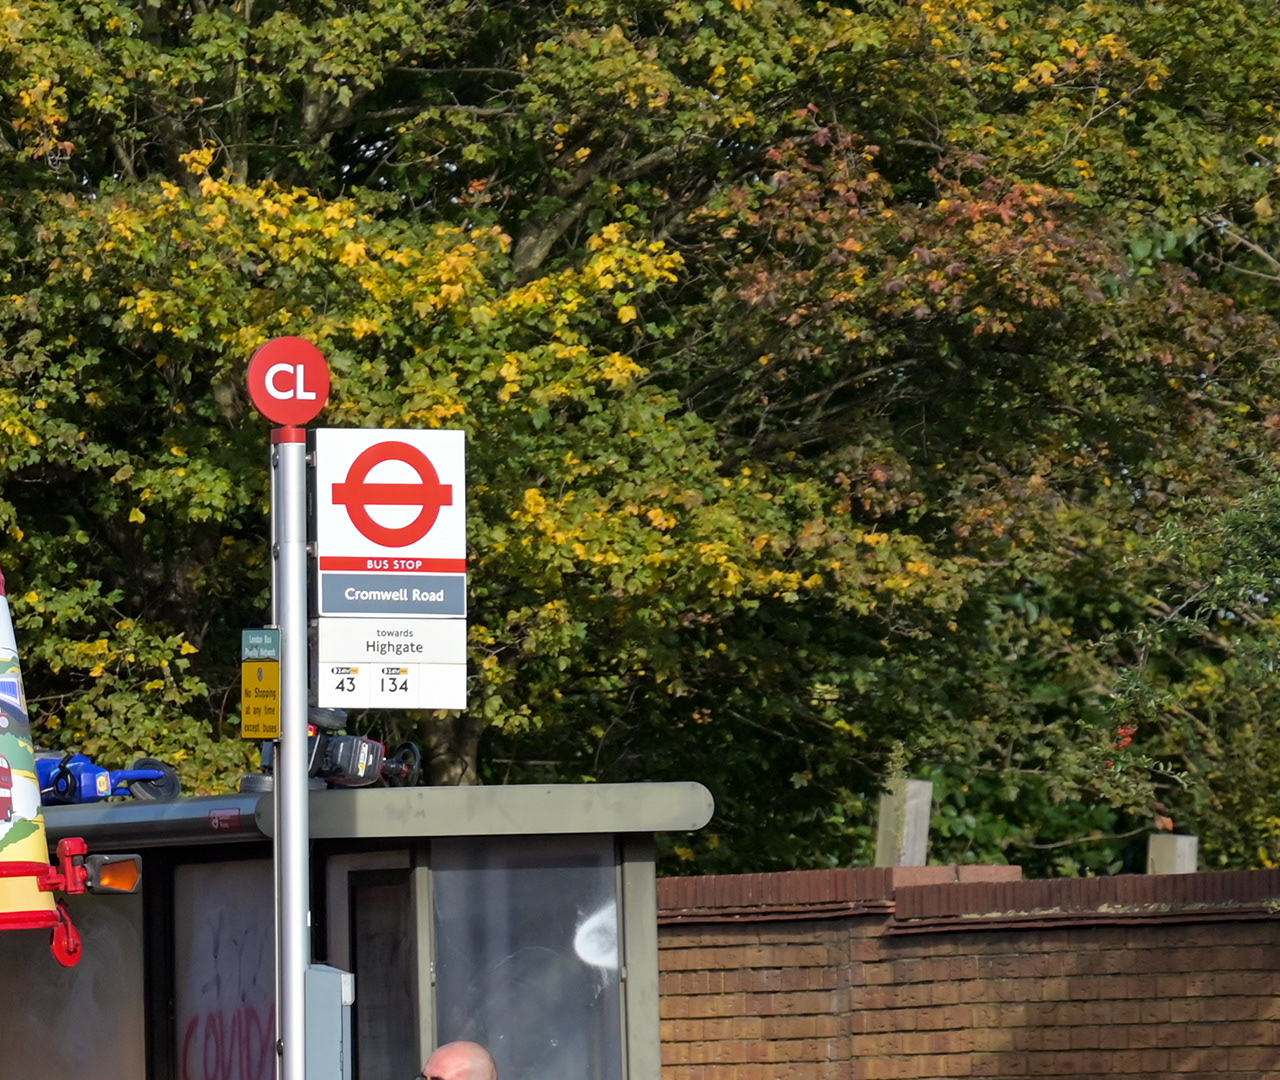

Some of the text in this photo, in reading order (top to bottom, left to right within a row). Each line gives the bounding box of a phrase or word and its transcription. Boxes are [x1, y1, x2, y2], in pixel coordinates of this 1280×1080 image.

[265, 363, 316, 400] CL
[366, 559, 422, 570] BUS STOP
[344, 587, 444, 602] Cromwell Road
[377, 629, 413, 638] towards
[366, 640, 423, 655] Highgate
[335, 677, 408, 692] 43 134
[244, 687, 276, 700] No Stopping
[245, 704, 275, 717] at any time
[244, 723, 277, 733] except buses
